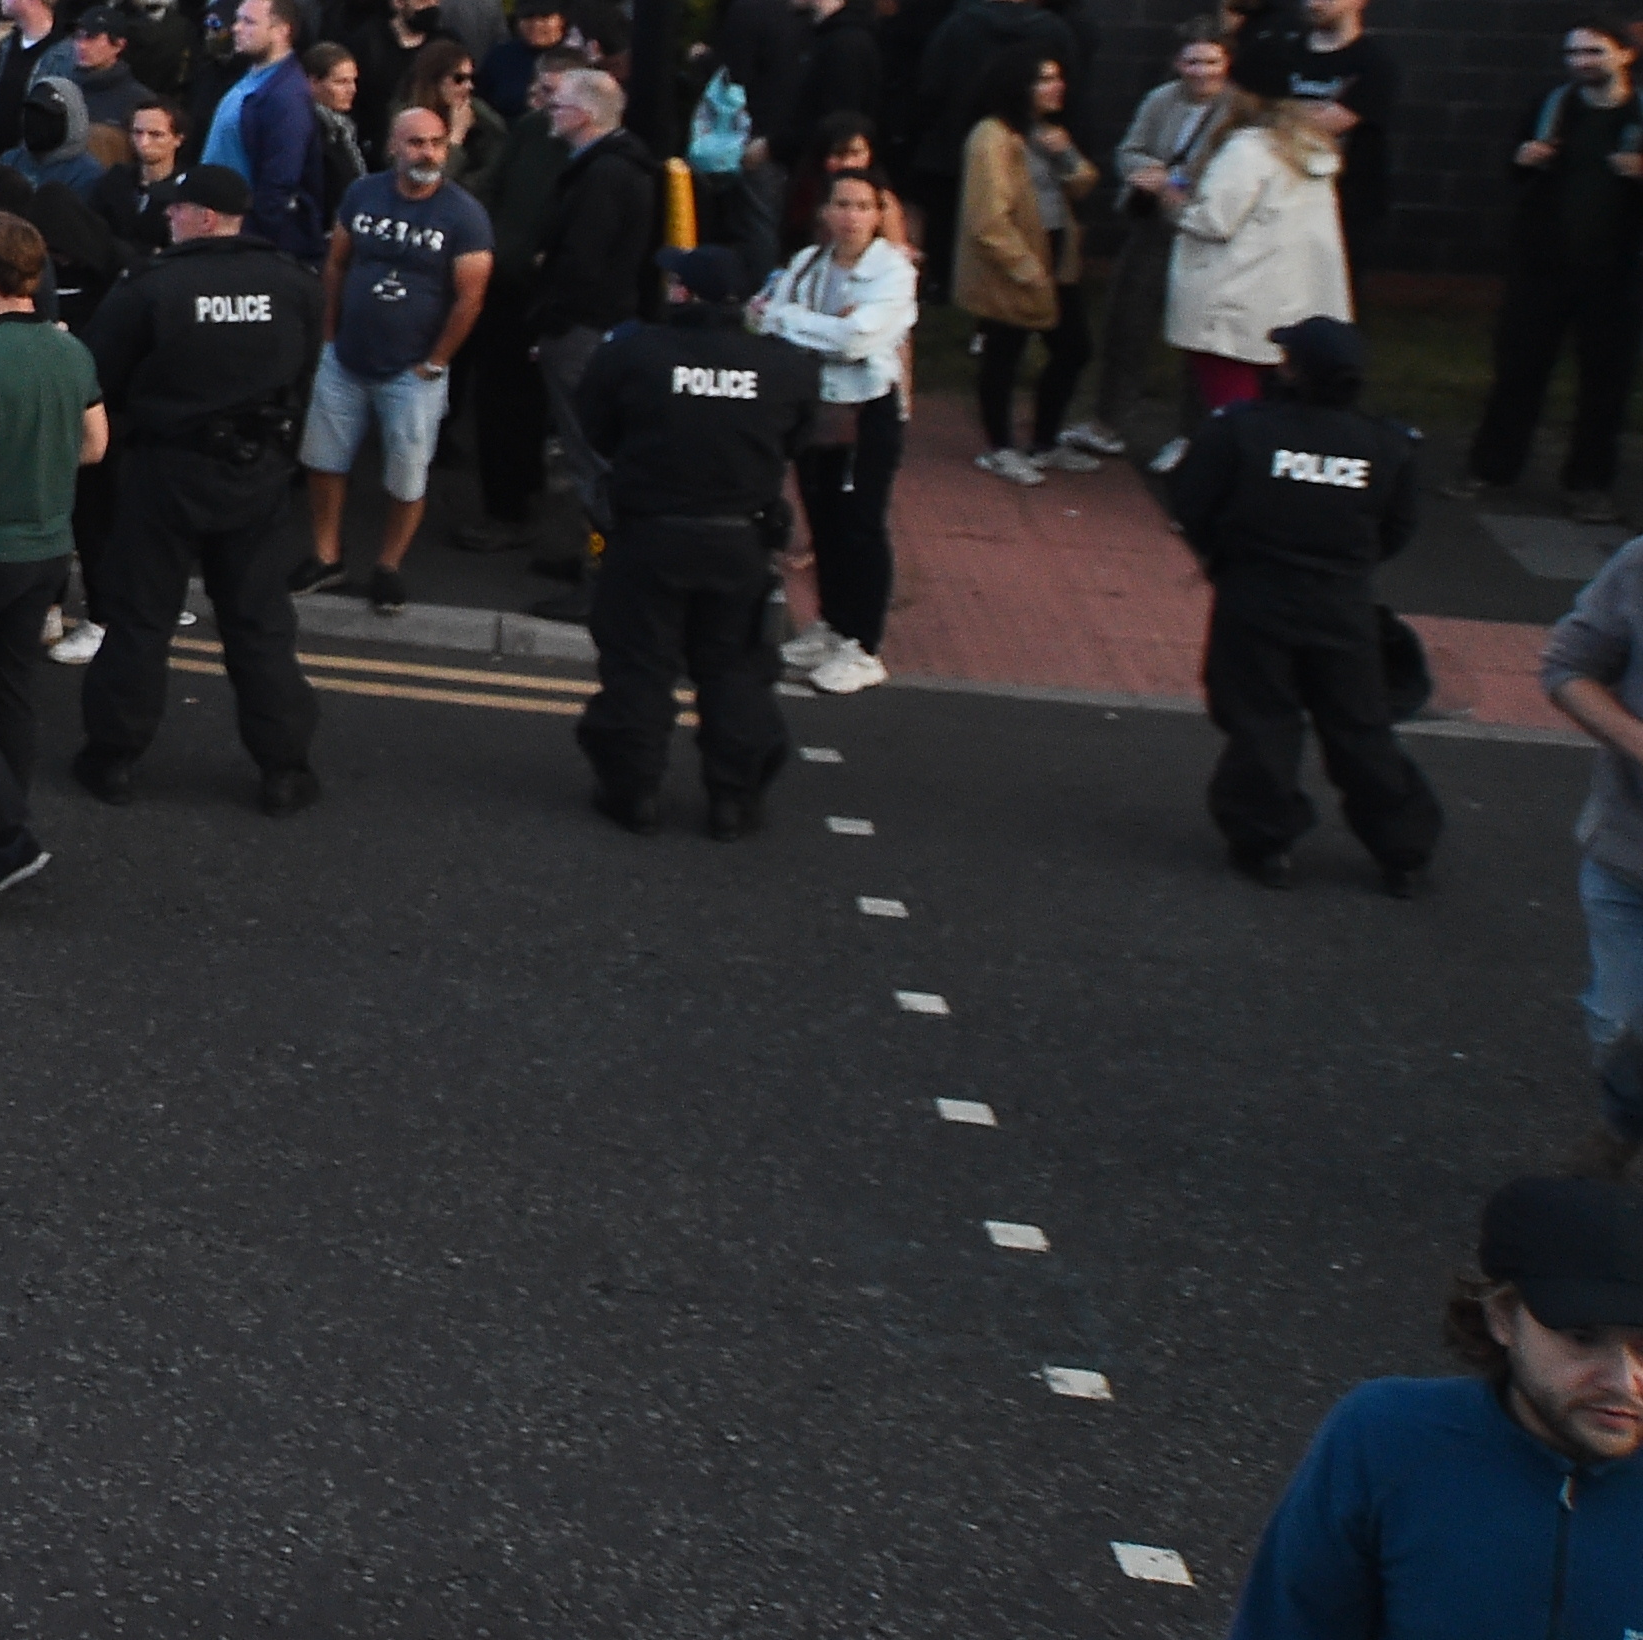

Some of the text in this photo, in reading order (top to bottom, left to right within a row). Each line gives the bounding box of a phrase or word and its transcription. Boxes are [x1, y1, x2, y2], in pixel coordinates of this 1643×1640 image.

[196, 295, 272, 322] POLICE
[672, 365, 759, 400] POLICE
[1270, 449, 1372, 490] POLICE
